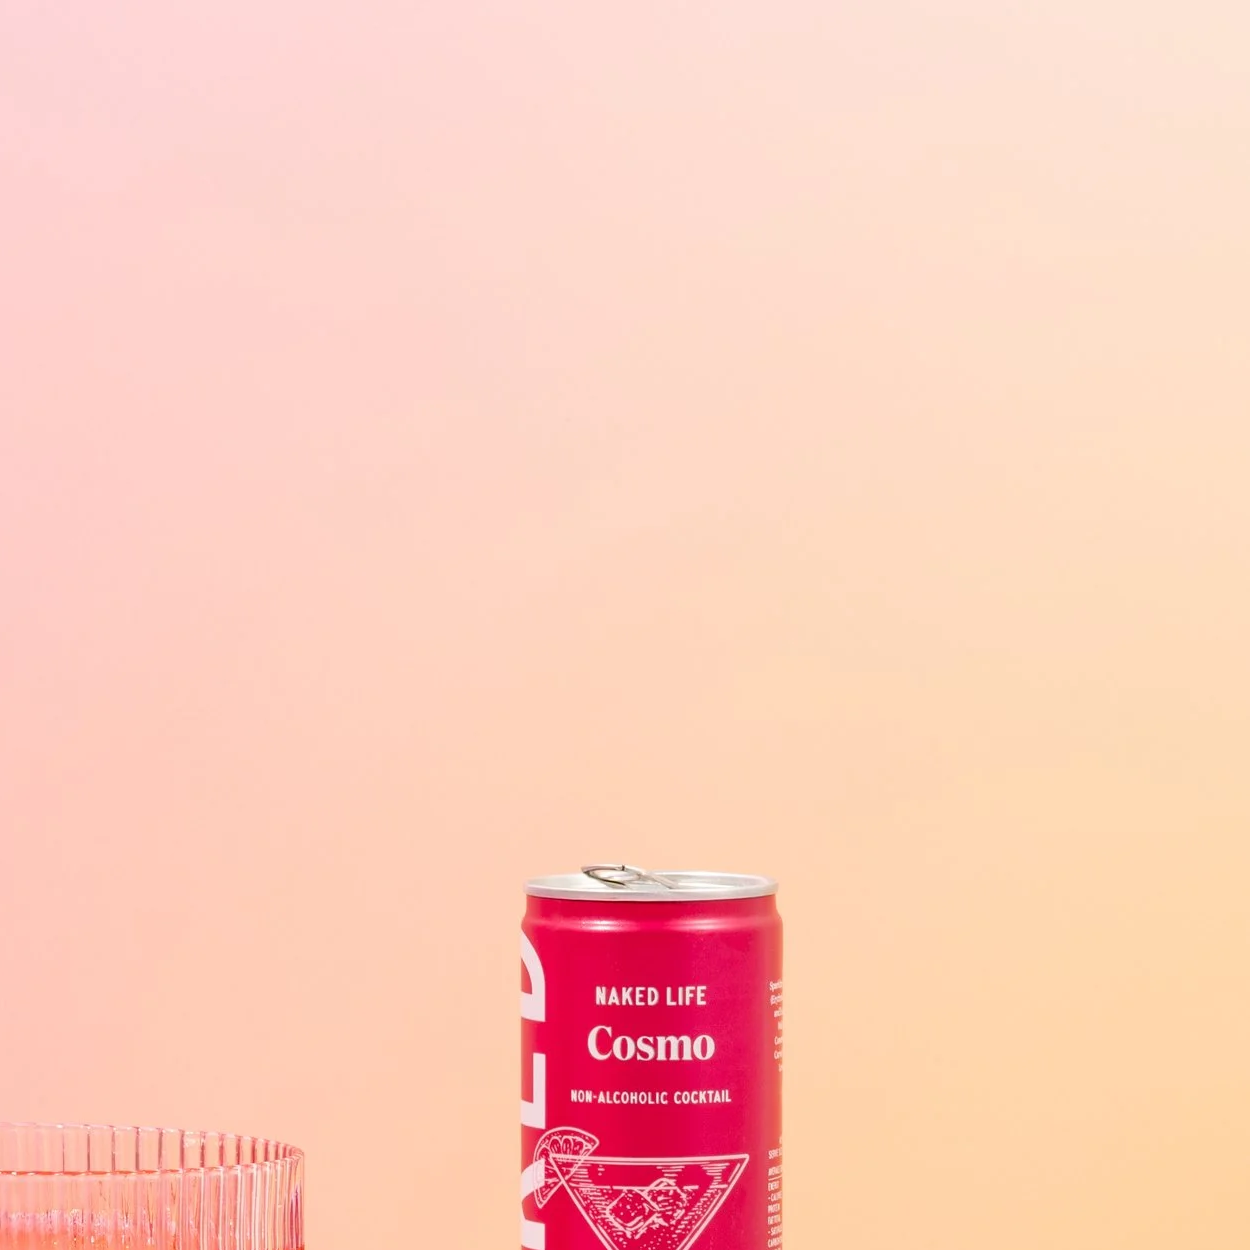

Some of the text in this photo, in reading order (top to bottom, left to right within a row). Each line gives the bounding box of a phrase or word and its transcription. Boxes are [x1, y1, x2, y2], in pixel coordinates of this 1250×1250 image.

[595, 985, 707, 1006] NAKED LIFE
[587, 1025, 716, 1061] Cosmo
[570, 1089, 732, 1105] NON-ALCOHOLIC COCKTAIL
